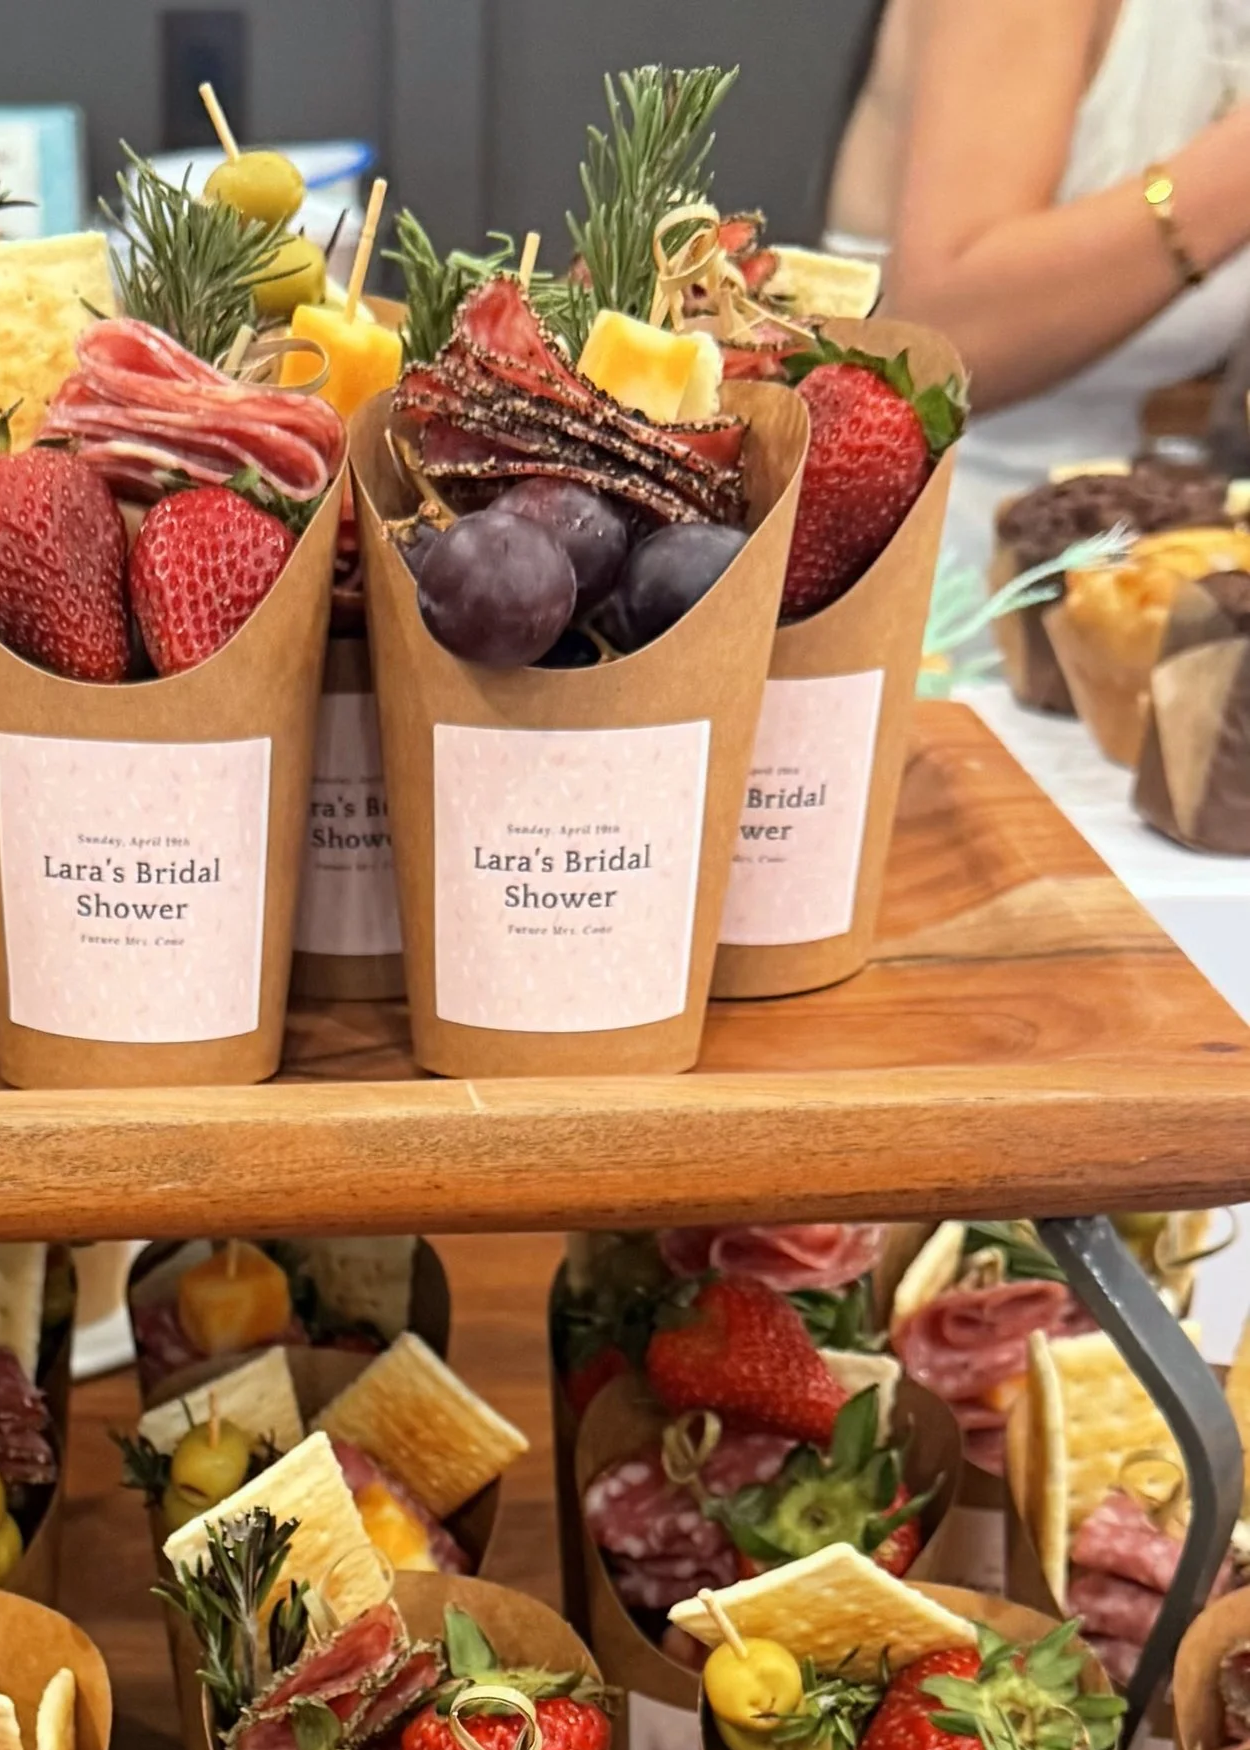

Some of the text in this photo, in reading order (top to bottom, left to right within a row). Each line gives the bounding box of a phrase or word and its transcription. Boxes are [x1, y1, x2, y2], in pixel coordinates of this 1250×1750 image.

[746, 784, 827, 809] Bridal
[129, 836, 161, 849] April
[310, 826, 392, 849] Show
[740, 825, 793, 840] wer
[43, 855, 222, 885] Lara's Bridal
[474, 843, 653, 873] Lara's Bridal
[76, 893, 189, 920] Shower
[504, 882, 618, 909] Shower
